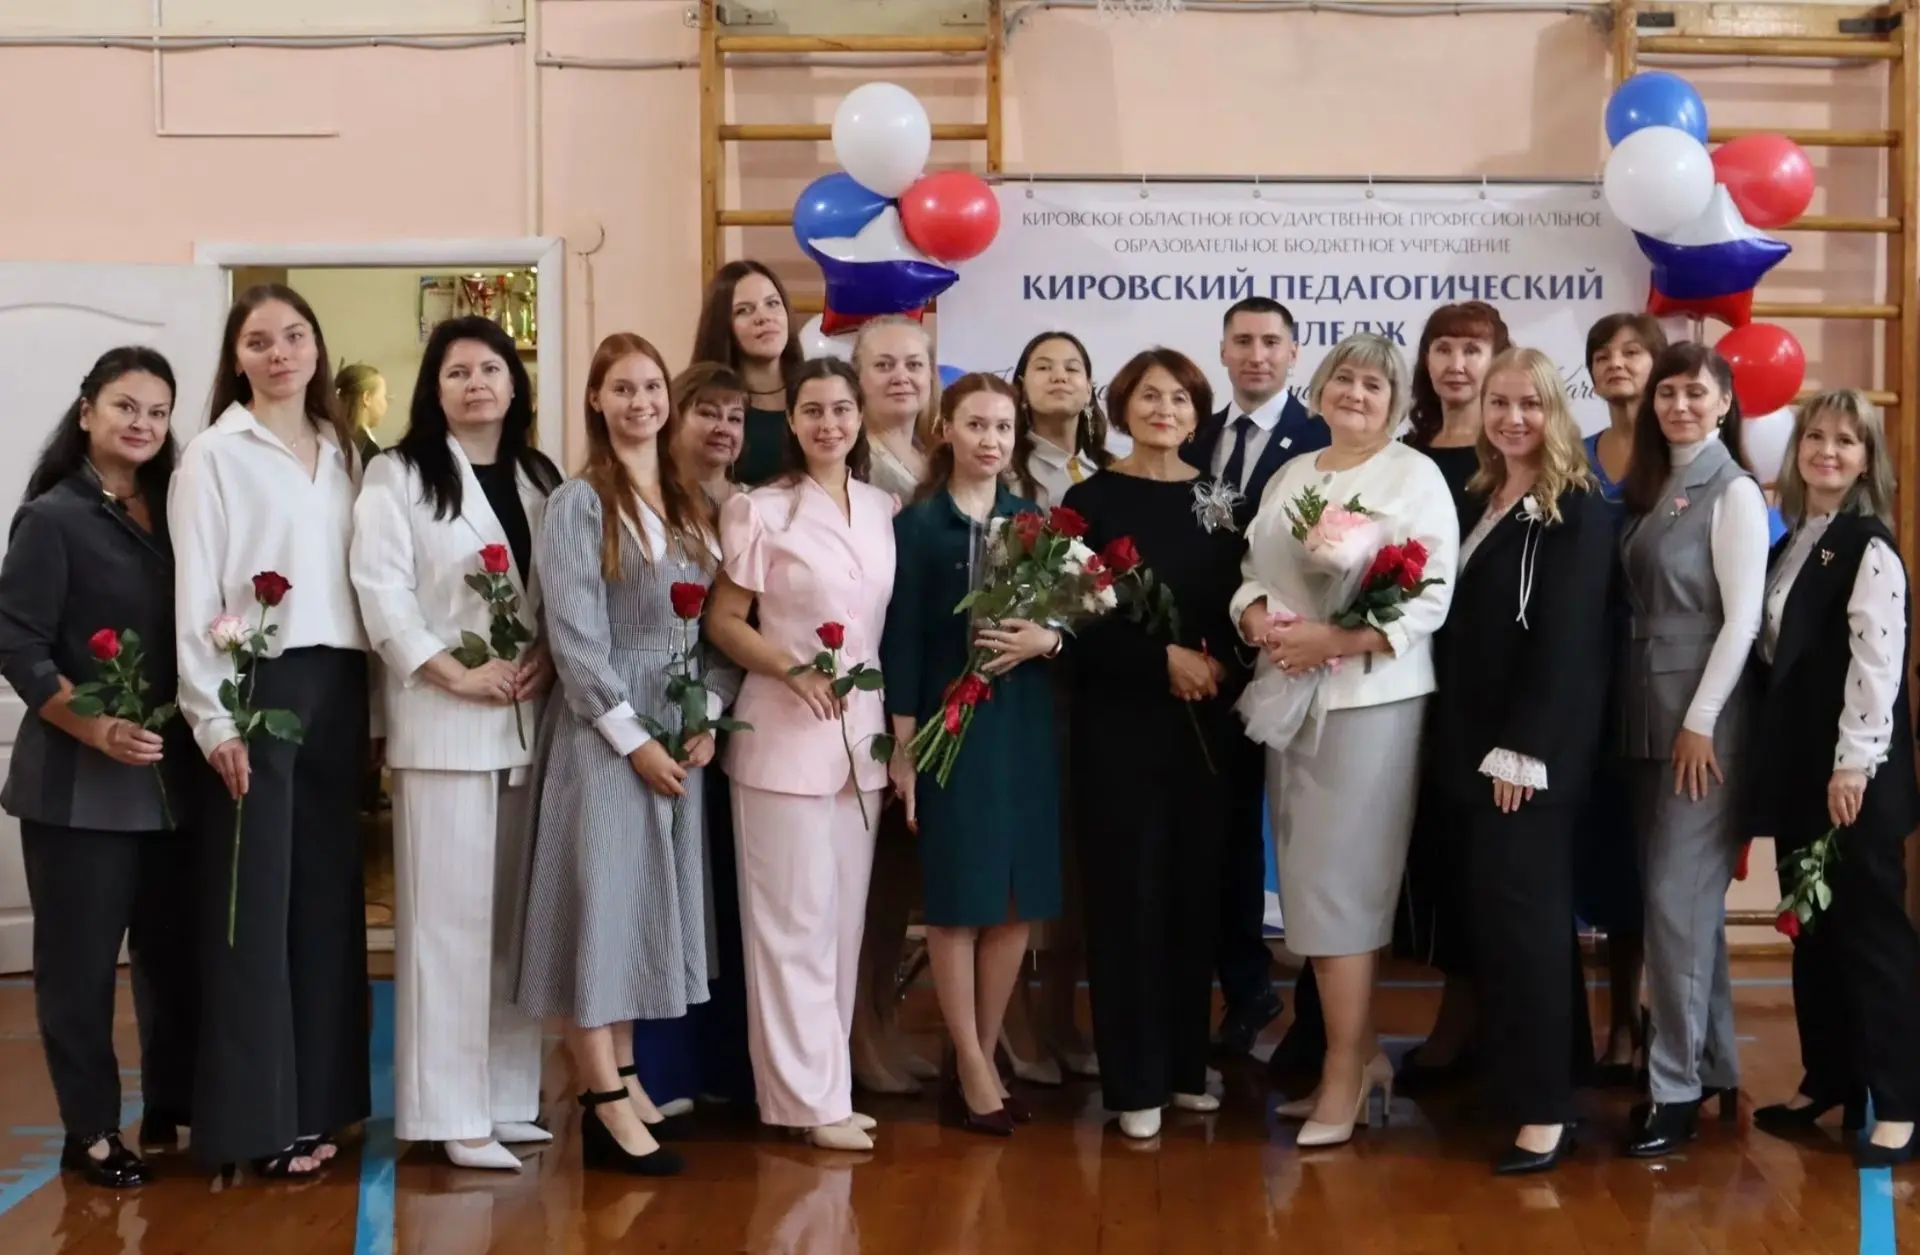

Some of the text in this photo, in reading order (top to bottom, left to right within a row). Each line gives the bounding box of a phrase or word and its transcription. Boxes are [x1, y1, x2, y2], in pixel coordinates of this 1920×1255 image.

[1022, 211, 1602, 228] КИРОВСКОЕ ОБЛАСТНОЕ ГОСУДАРСТВЕННОЕ ПРОФЕССИОНАЛЬНОЕ
[1114, 238, 1511, 255] ОБРАЗОВАТЕЛЬНОЕ БЮДЖЕТНОЕ УЧРЕЖДЕНИЕ
[1023, 266, 1603, 304] КИРОВСКИЙ ПЕДАГОГИЧЕСКИЙ
